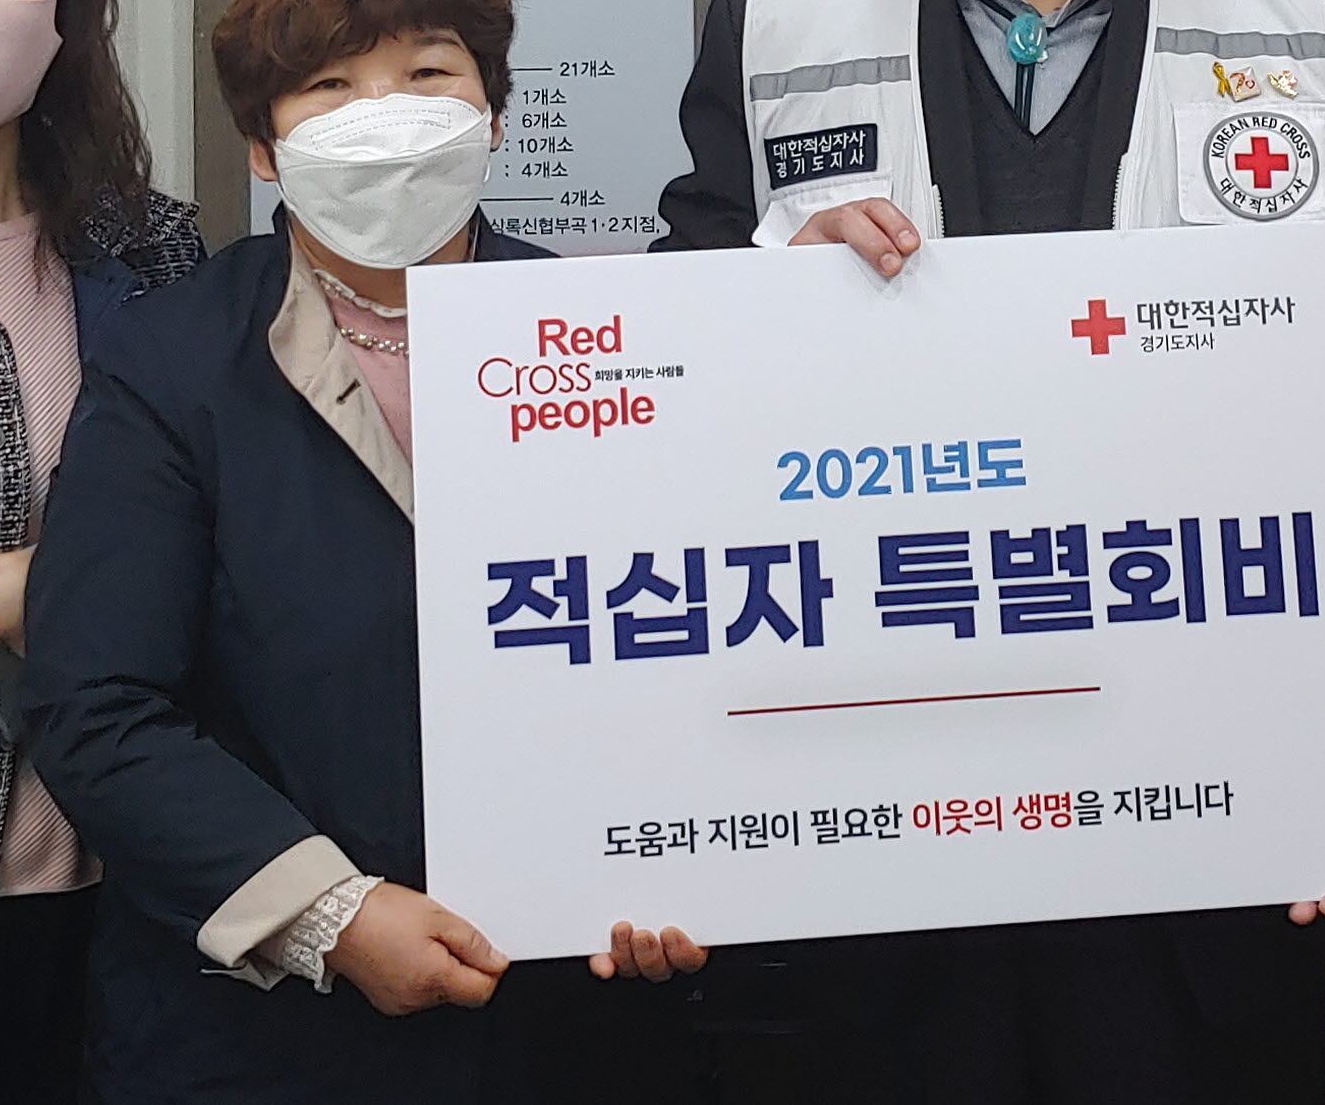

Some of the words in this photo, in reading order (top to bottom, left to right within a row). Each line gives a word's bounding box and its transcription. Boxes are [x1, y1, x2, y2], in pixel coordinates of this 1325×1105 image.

[560, 61, 615, 77] 21개소
[773, 130, 866, 160] 대한적십자사
[1211, 119, 1250, 158] KOREAN
[1253, 116, 1277, 128] RED
[1280, 123, 1310, 159] CROSS
[561, 190, 605, 207] 4개소
[1220, 176, 1308, 213] 대한적십자사
[1137, 296, 1295, 330] 대한적십자사
[538, 316, 623, 357] Red
[1139, 333, 1215, 354] 경기도지사
[478, 357, 591, 398] Cross
[594, 368, 623, 382] 희망을
[625, 367, 654, 380] 지키는
[656, 365, 685, 378] 사람들
[510, 389, 656, 442] people
[777, 438, 1027, 502] 2021년도
[486, 539, 833, 666] 적십자
[875, 512, 1319, 638] 특별회비
[604, 821, 699, 859] 도움과
[707, 813, 801, 849] 지원이
[809, 804, 903, 845] 필요한
[912, 797, 1004, 837] 이웃의
[1012, 790, 1103, 830] 생명을
[1113, 781, 1234, 822] 지킵니다
